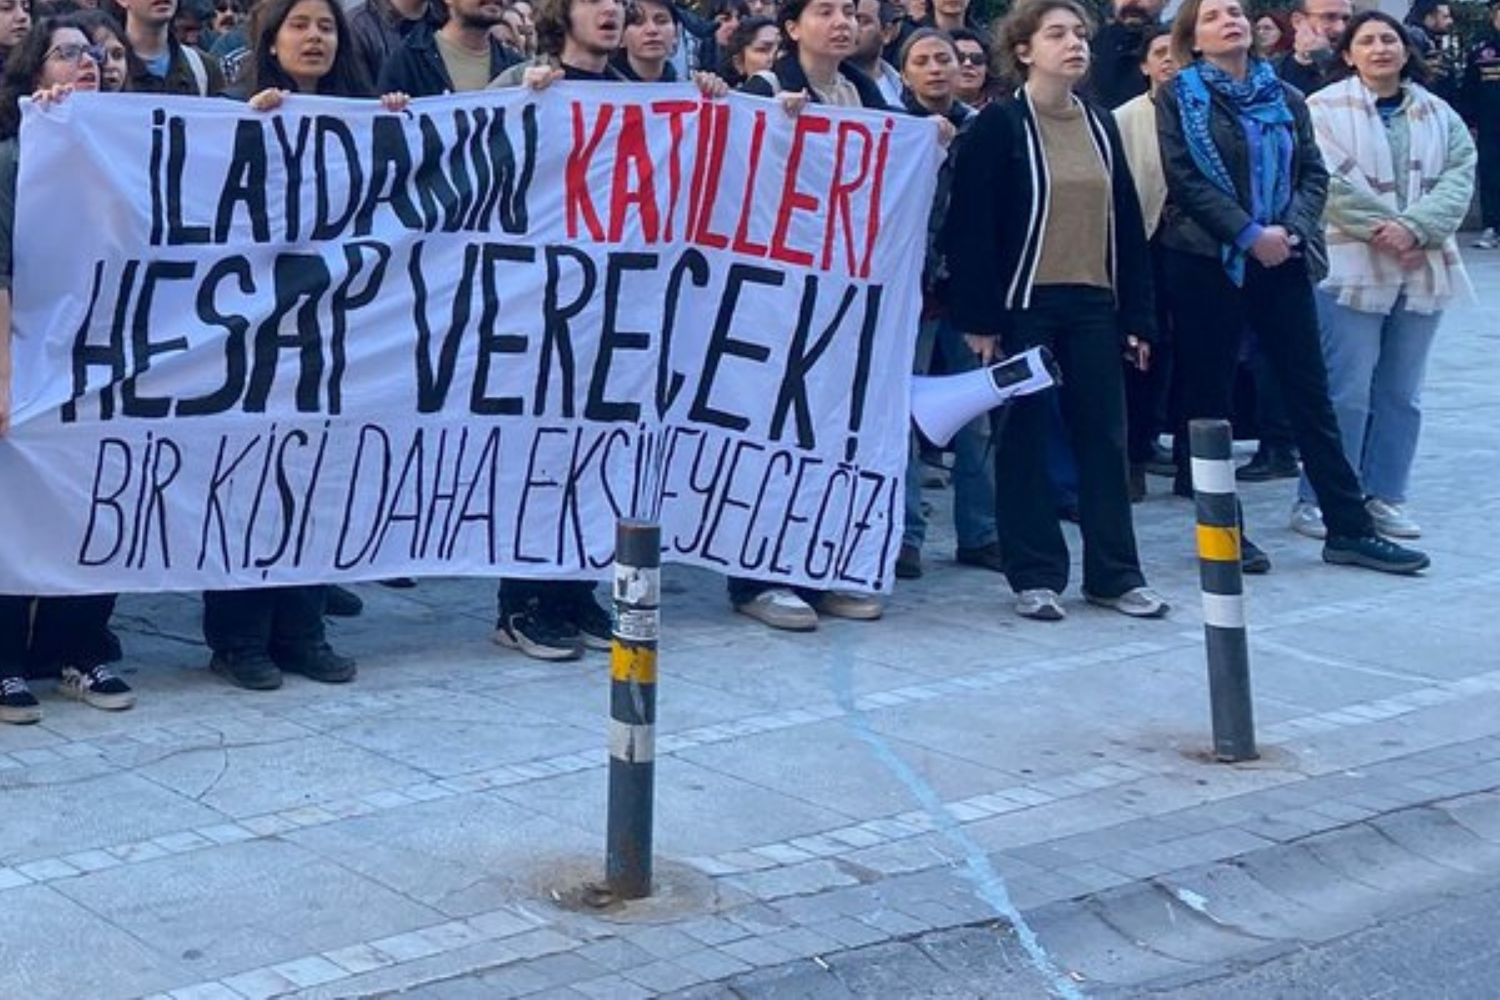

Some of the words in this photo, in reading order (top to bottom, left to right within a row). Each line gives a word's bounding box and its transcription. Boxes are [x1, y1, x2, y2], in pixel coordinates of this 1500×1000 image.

[565, 92, 896, 279] KATİLLERİ
[61, 240, 391, 423] HESAP
[408, 240, 884, 463] VERECEK!
[78, 430, 182, 569] BİR
[197, 420, 332, 580] KİŞİ
[333, 424, 501, 570] DAHA
